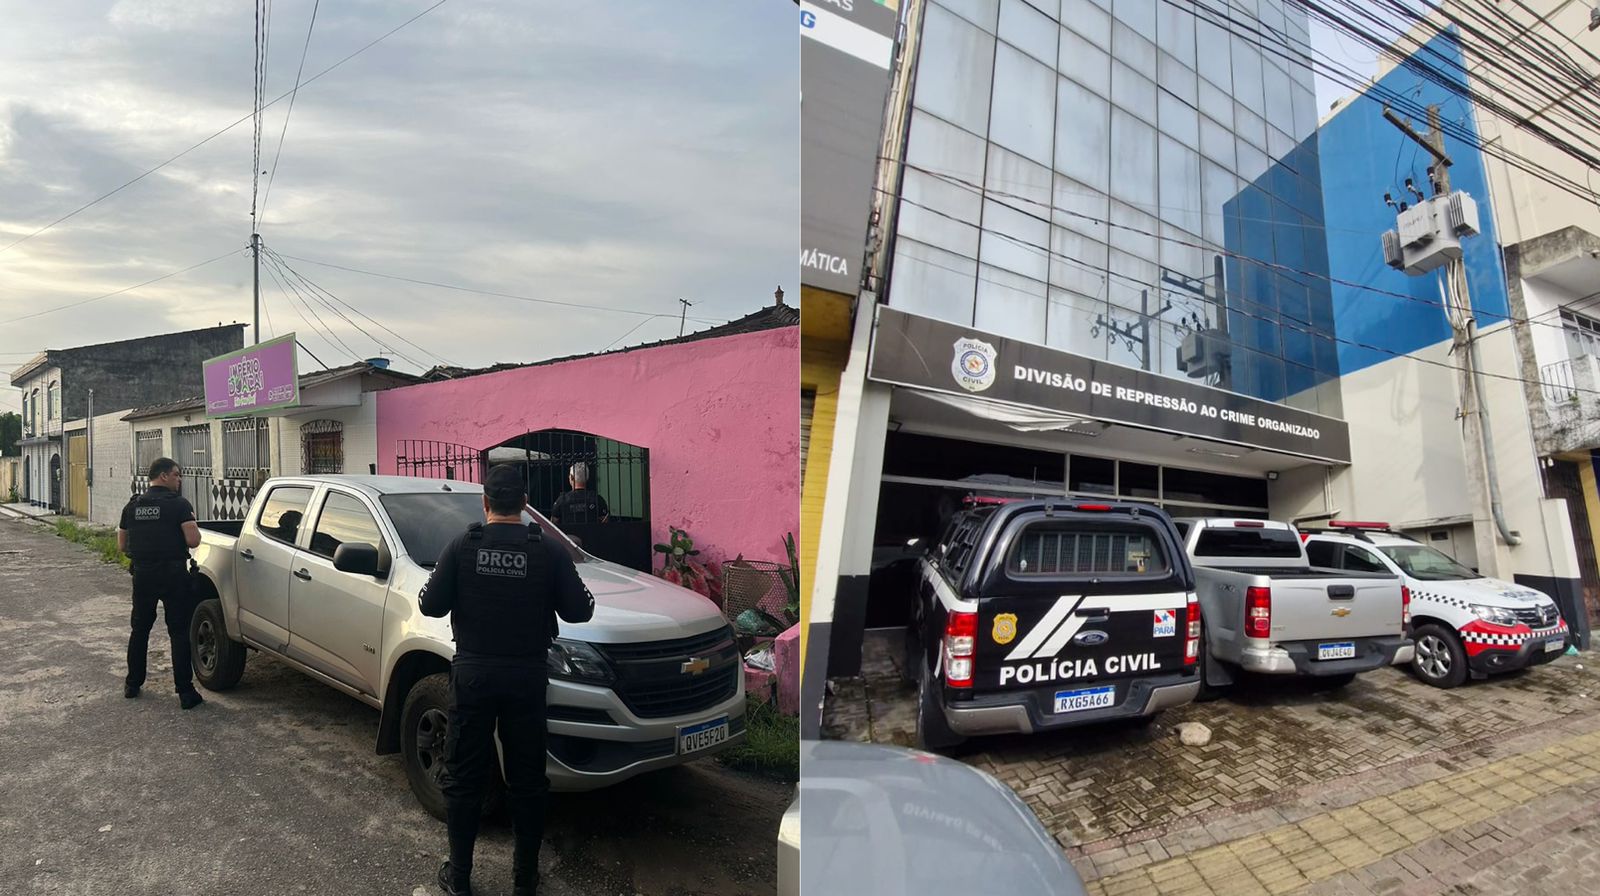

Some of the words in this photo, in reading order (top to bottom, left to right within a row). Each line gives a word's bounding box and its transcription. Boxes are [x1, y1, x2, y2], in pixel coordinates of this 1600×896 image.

[962, 376, 984, 385] CIVIL
[1014, 364, 1087, 393] DIVISÃO
[1091, 380, 1112, 396] DE
[1116, 386, 1197, 414] REPRESSÃO
[1200, 405, 1218, 418] AO
[1220, 408, 1256, 426] CRIME
[1258, 416, 1321, 440] ORGANIZADO
[135, 507, 160, 516] DRCO
[478, 551, 525, 568] DRCO
[999, 657, 1098, 686] POLÍCIA
[1104, 653, 1161, 673] CIVIL
[1060, 693, 1109, 710] RXG5A66
[686, 726, 725, 751] QVE5F20
